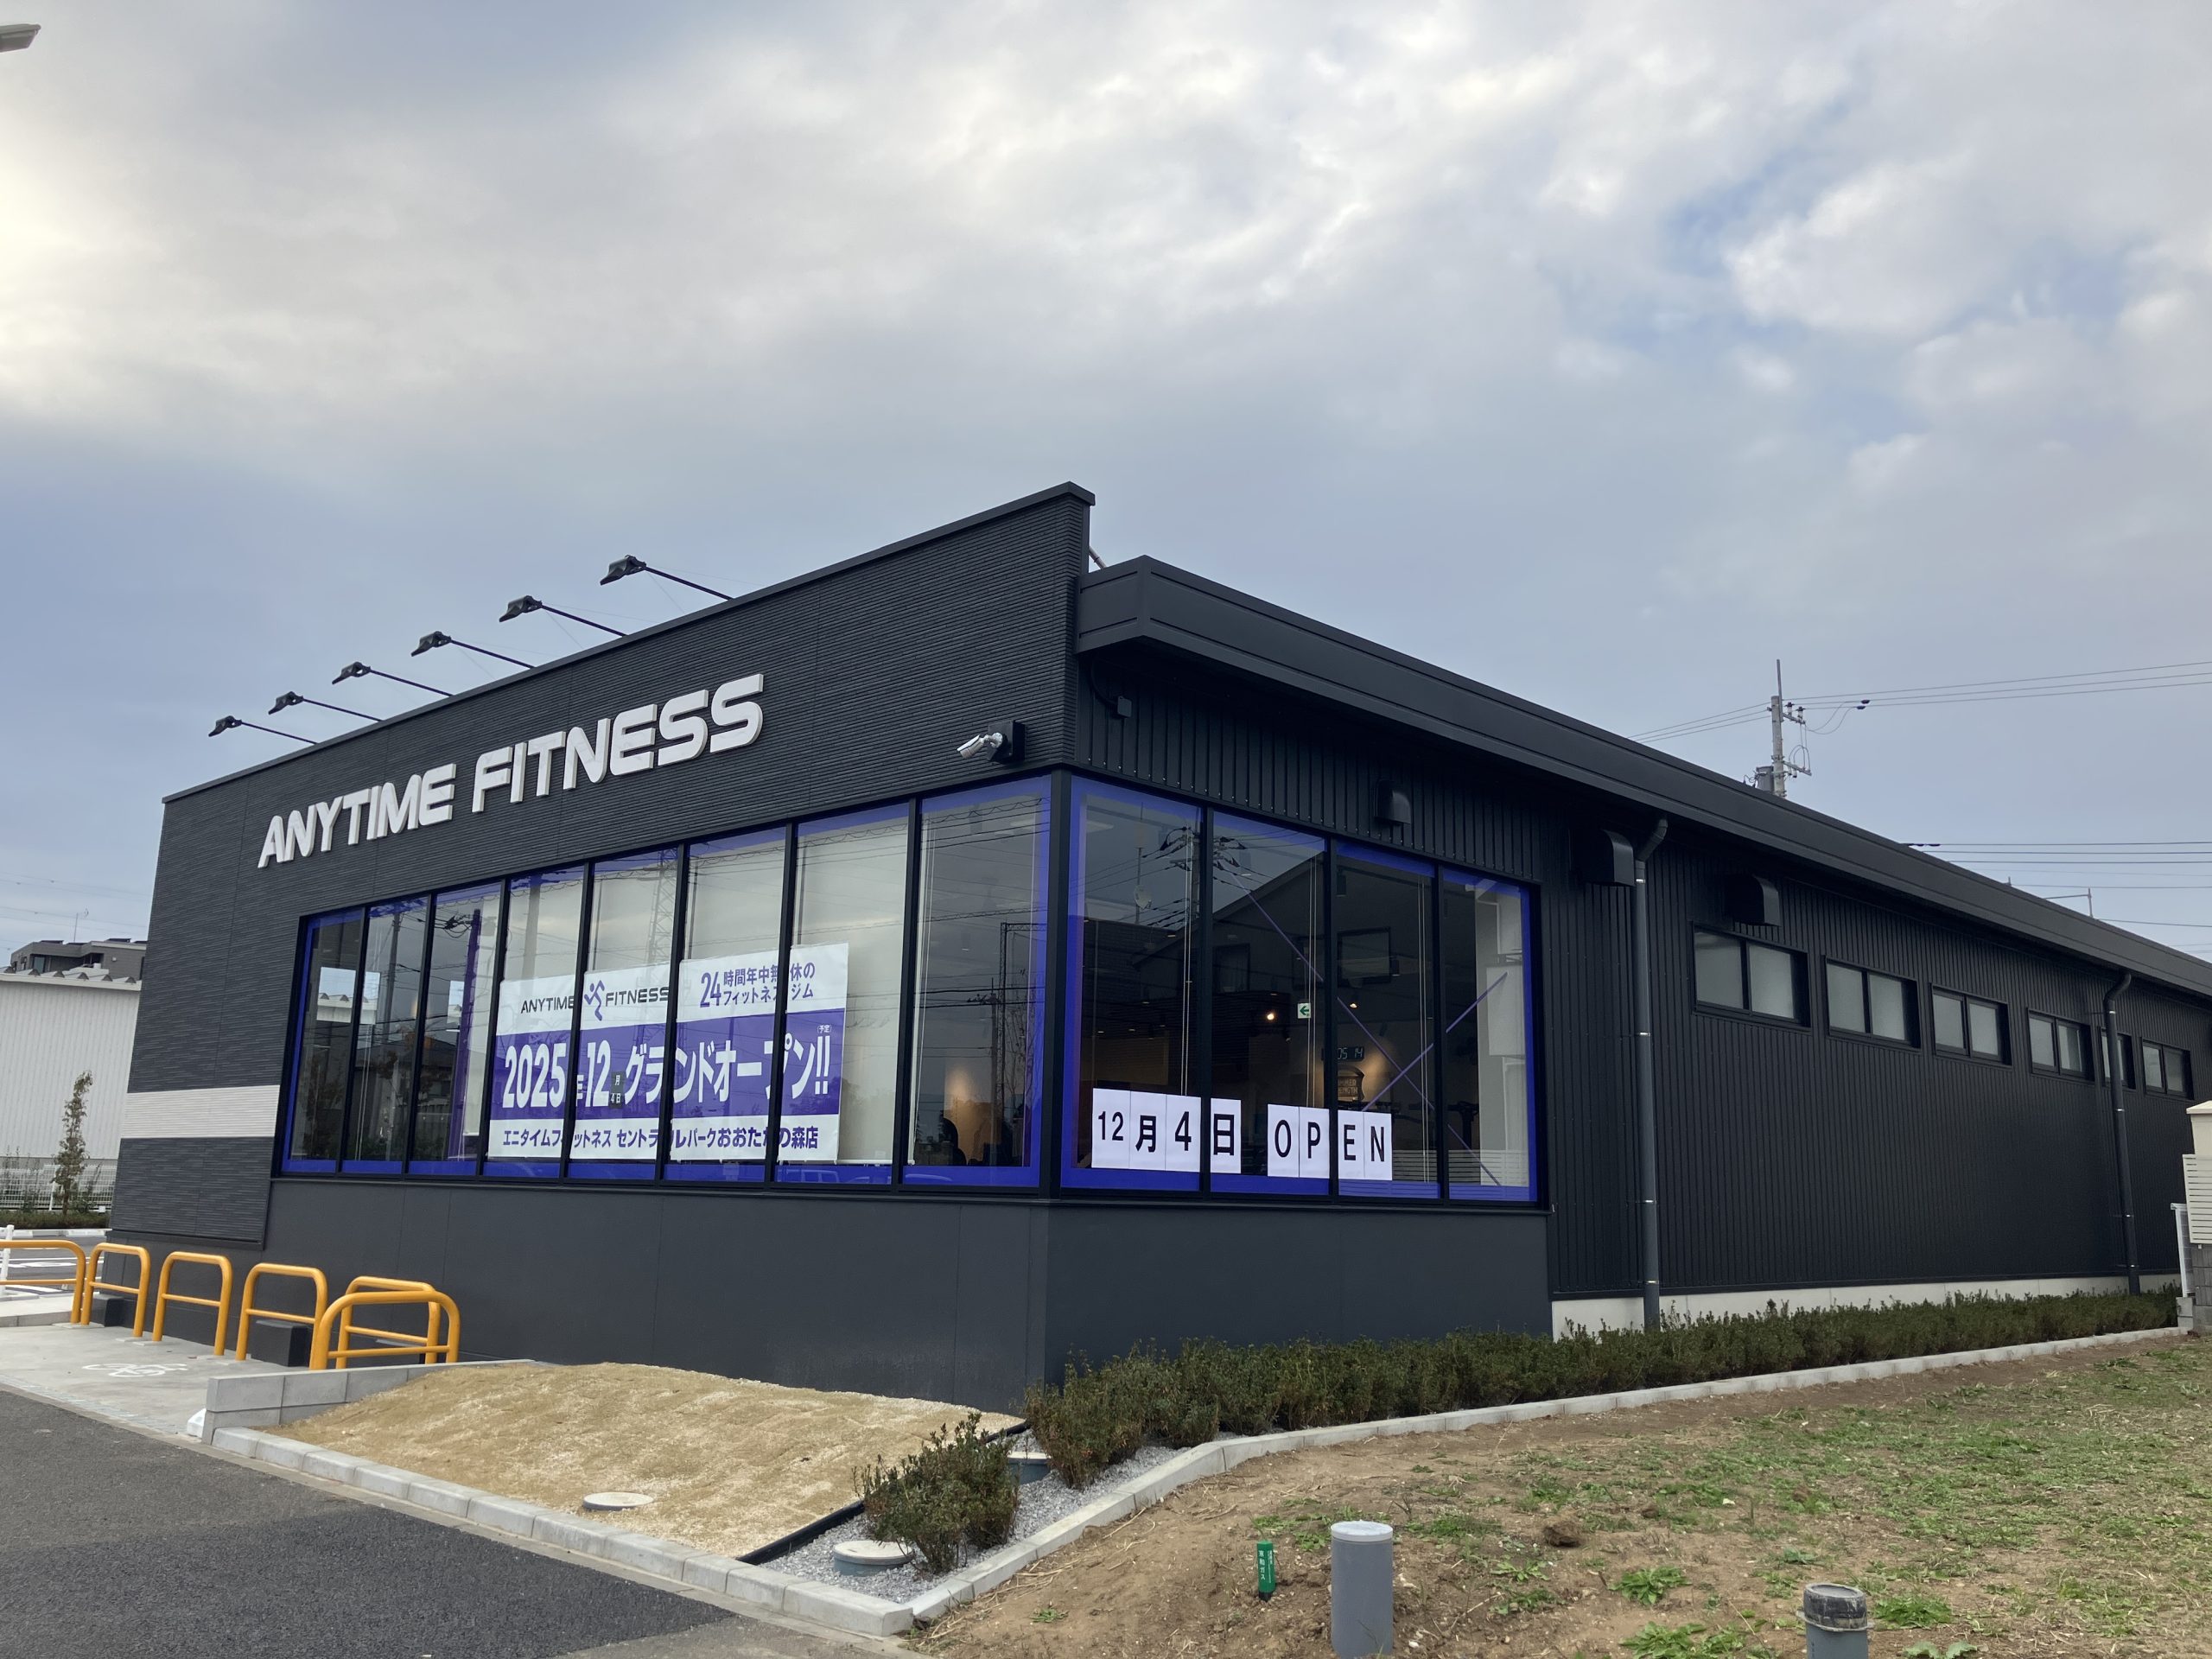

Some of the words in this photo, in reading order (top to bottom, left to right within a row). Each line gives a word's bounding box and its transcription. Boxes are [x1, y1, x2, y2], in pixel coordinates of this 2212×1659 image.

[257, 763, 456, 868] ANYTIME
[473, 674, 765, 813] FITNESS
[521, 995, 574, 1014] ANYTIME
[606, 987, 670, 1007] FITNESS
[503, 1128, 612, 1148] エニタイムフットネス
[1274, 1120, 1385, 1162] OPEN
